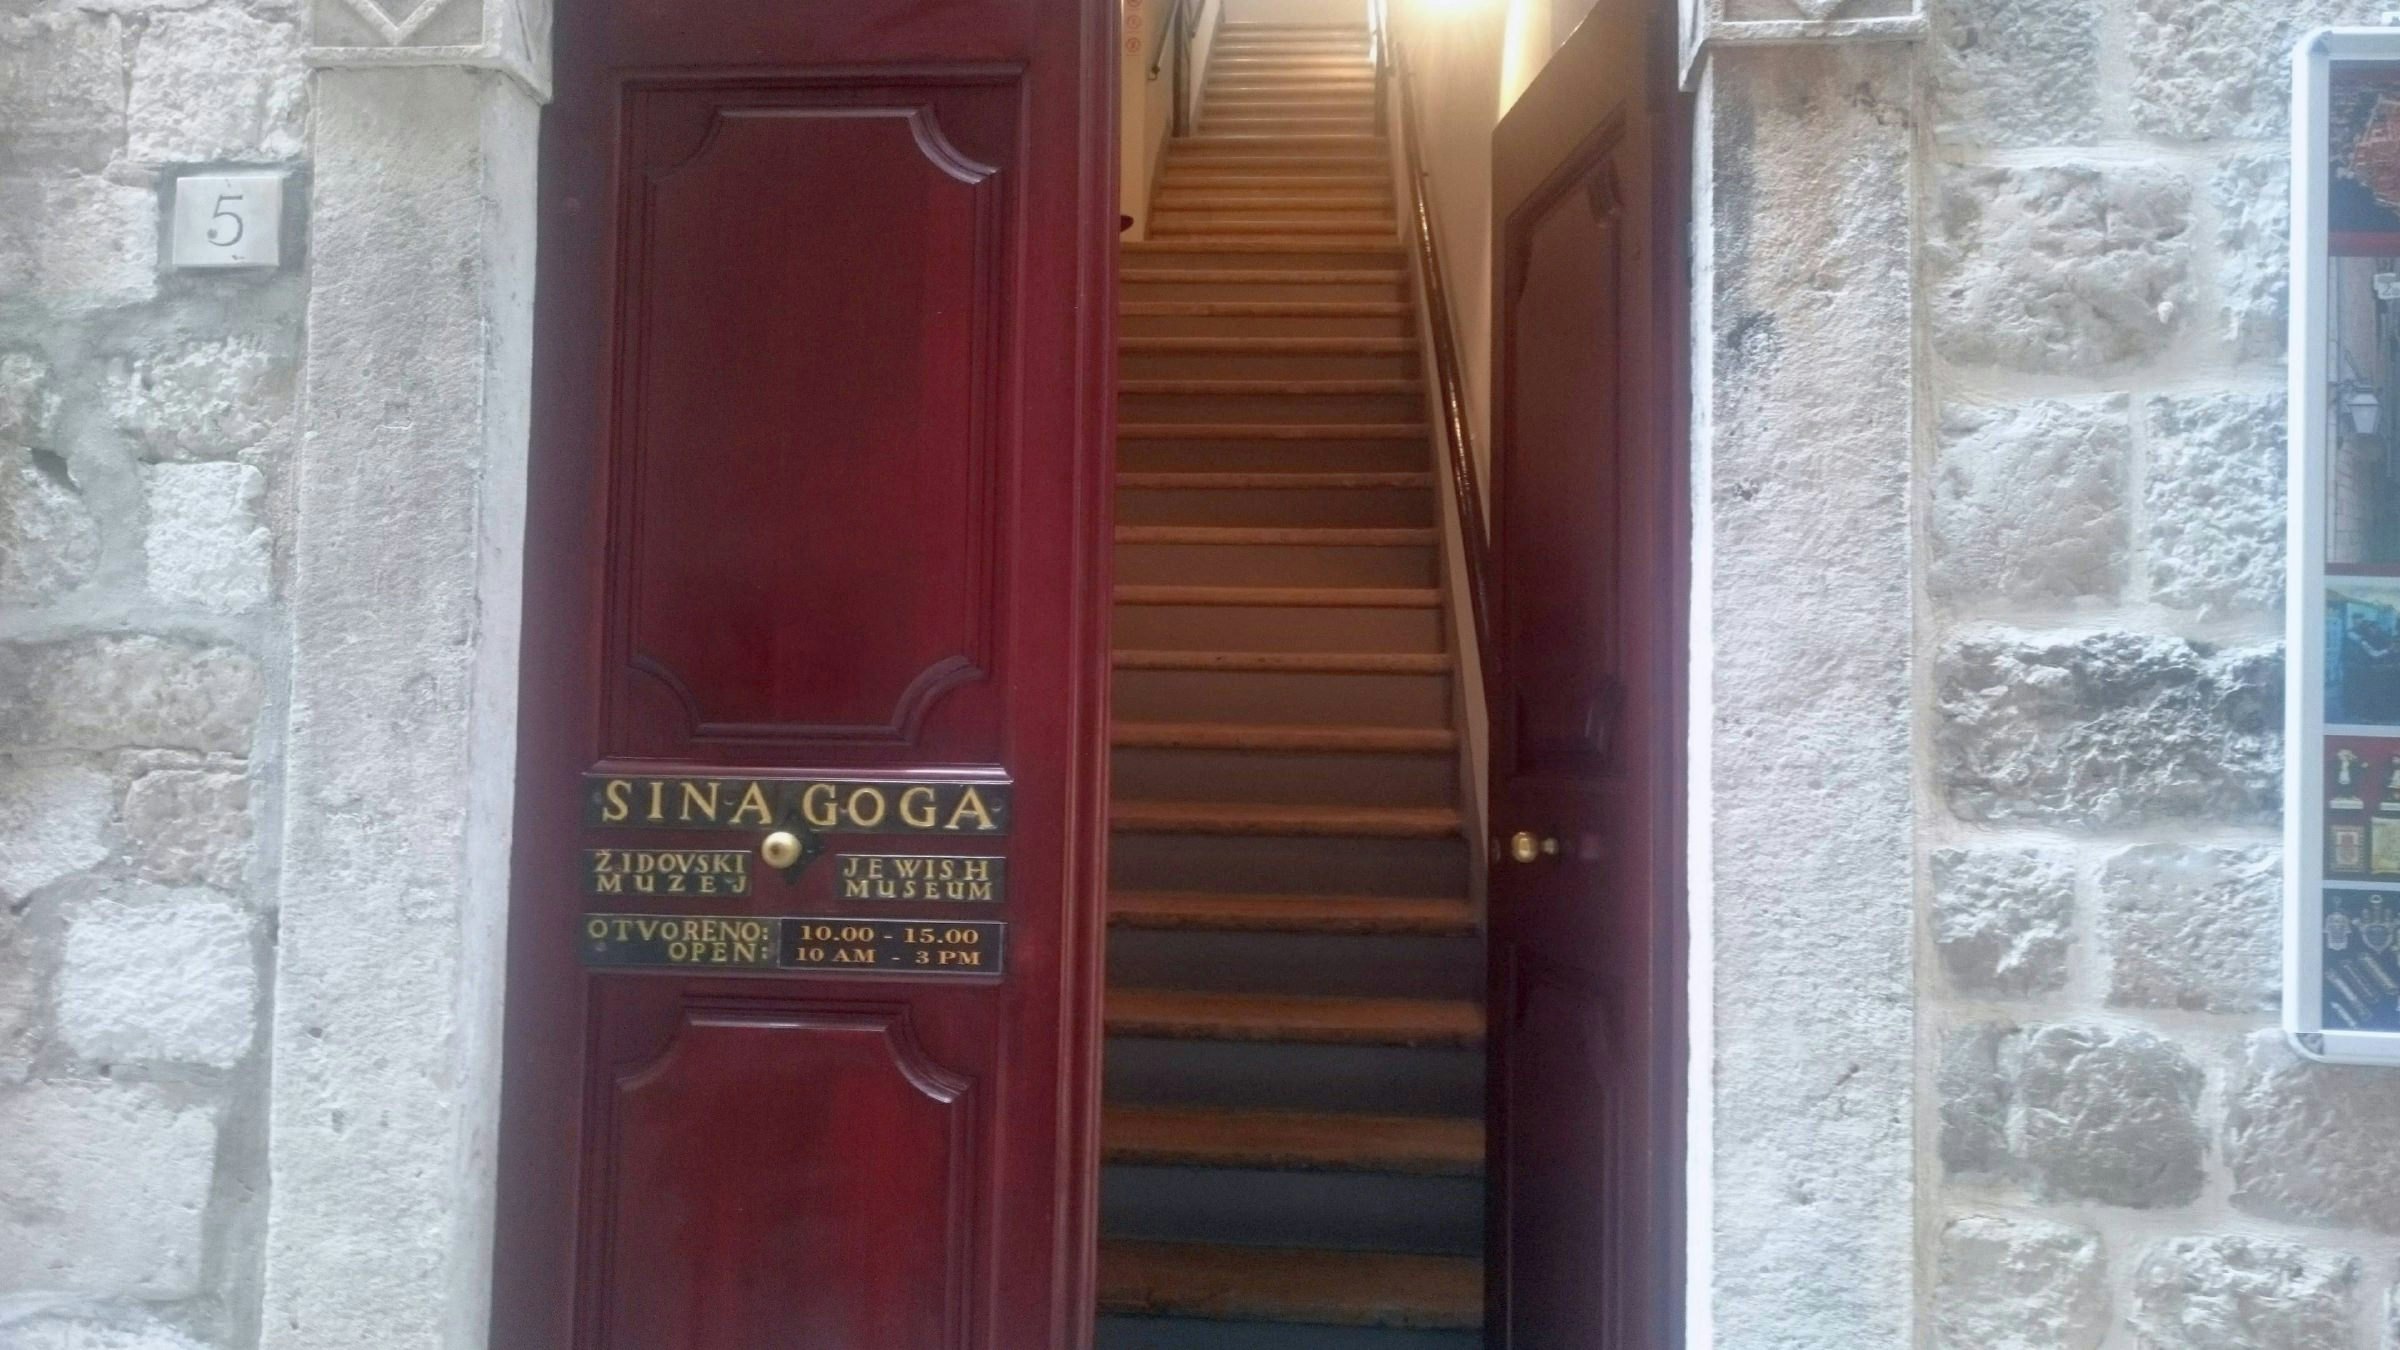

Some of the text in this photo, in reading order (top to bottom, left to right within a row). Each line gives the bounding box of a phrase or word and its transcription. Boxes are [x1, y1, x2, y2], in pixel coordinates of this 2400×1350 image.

[207, 194, 244, 247] 5
[843, 857, 989, 881] JEWISH
[596, 873, 747, 893] MUZEJ
[845, 879, 992, 901] MUSEUM
[588, 919, 769, 941] OTVORENO:
[801, 925, 875, 942] 10.00
[904, 928, 979, 944] 15.00
[668, 942, 769, 963] OPEN:
[796, 947, 825, 962] 10
[831, 948, 876, 963] AM
[914, 950, 930, 965] 3
[936, 951, 982, 966] PM
